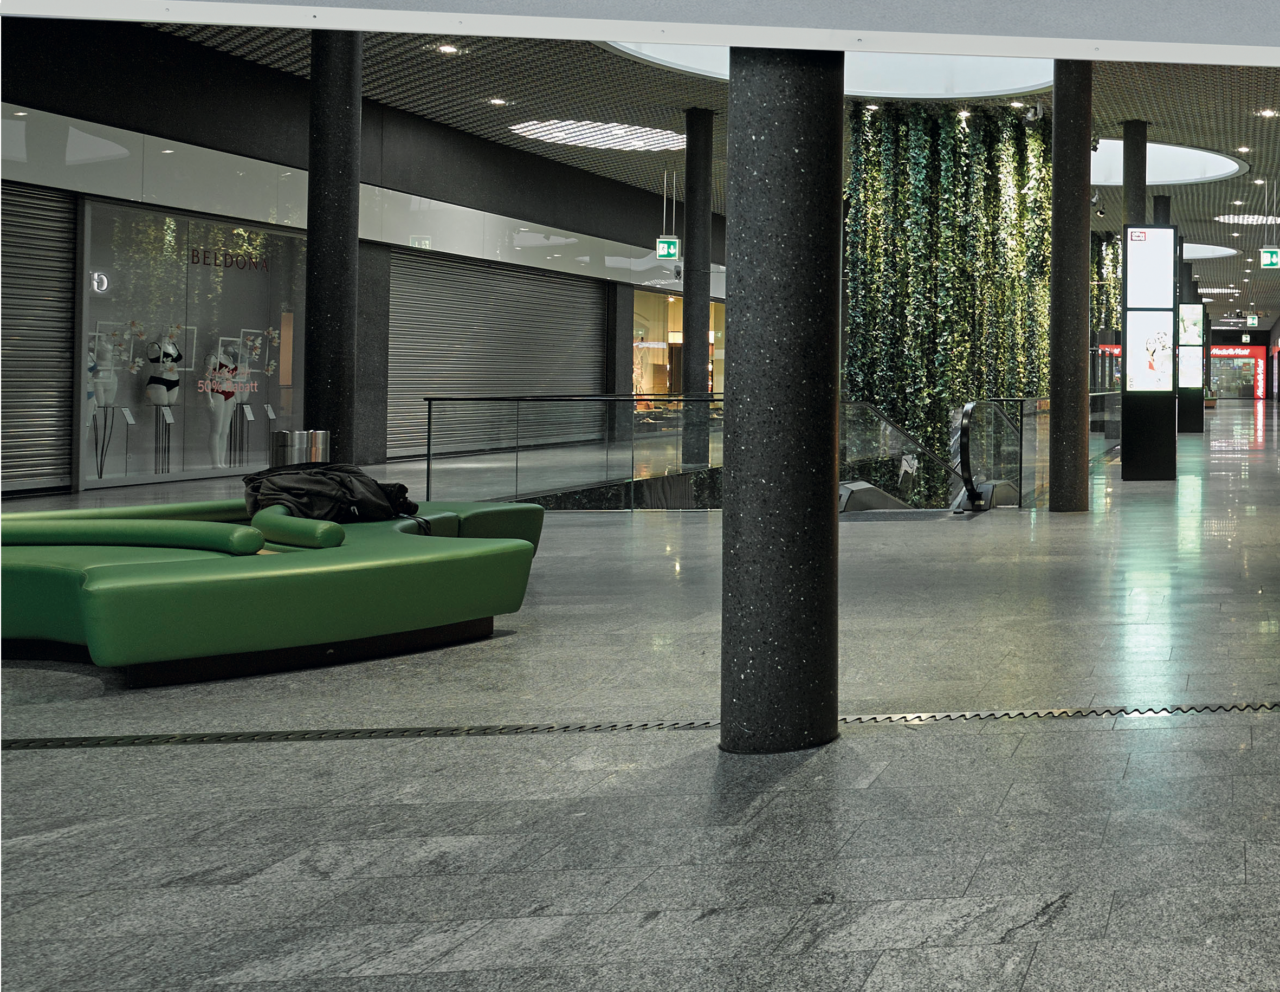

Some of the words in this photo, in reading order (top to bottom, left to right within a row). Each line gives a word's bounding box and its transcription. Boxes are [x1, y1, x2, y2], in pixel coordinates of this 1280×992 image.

[191, 248, 269, 272] BELDONA
[197, 380, 222, 393] 50%
[225, 380, 259, 393] Rabatt
